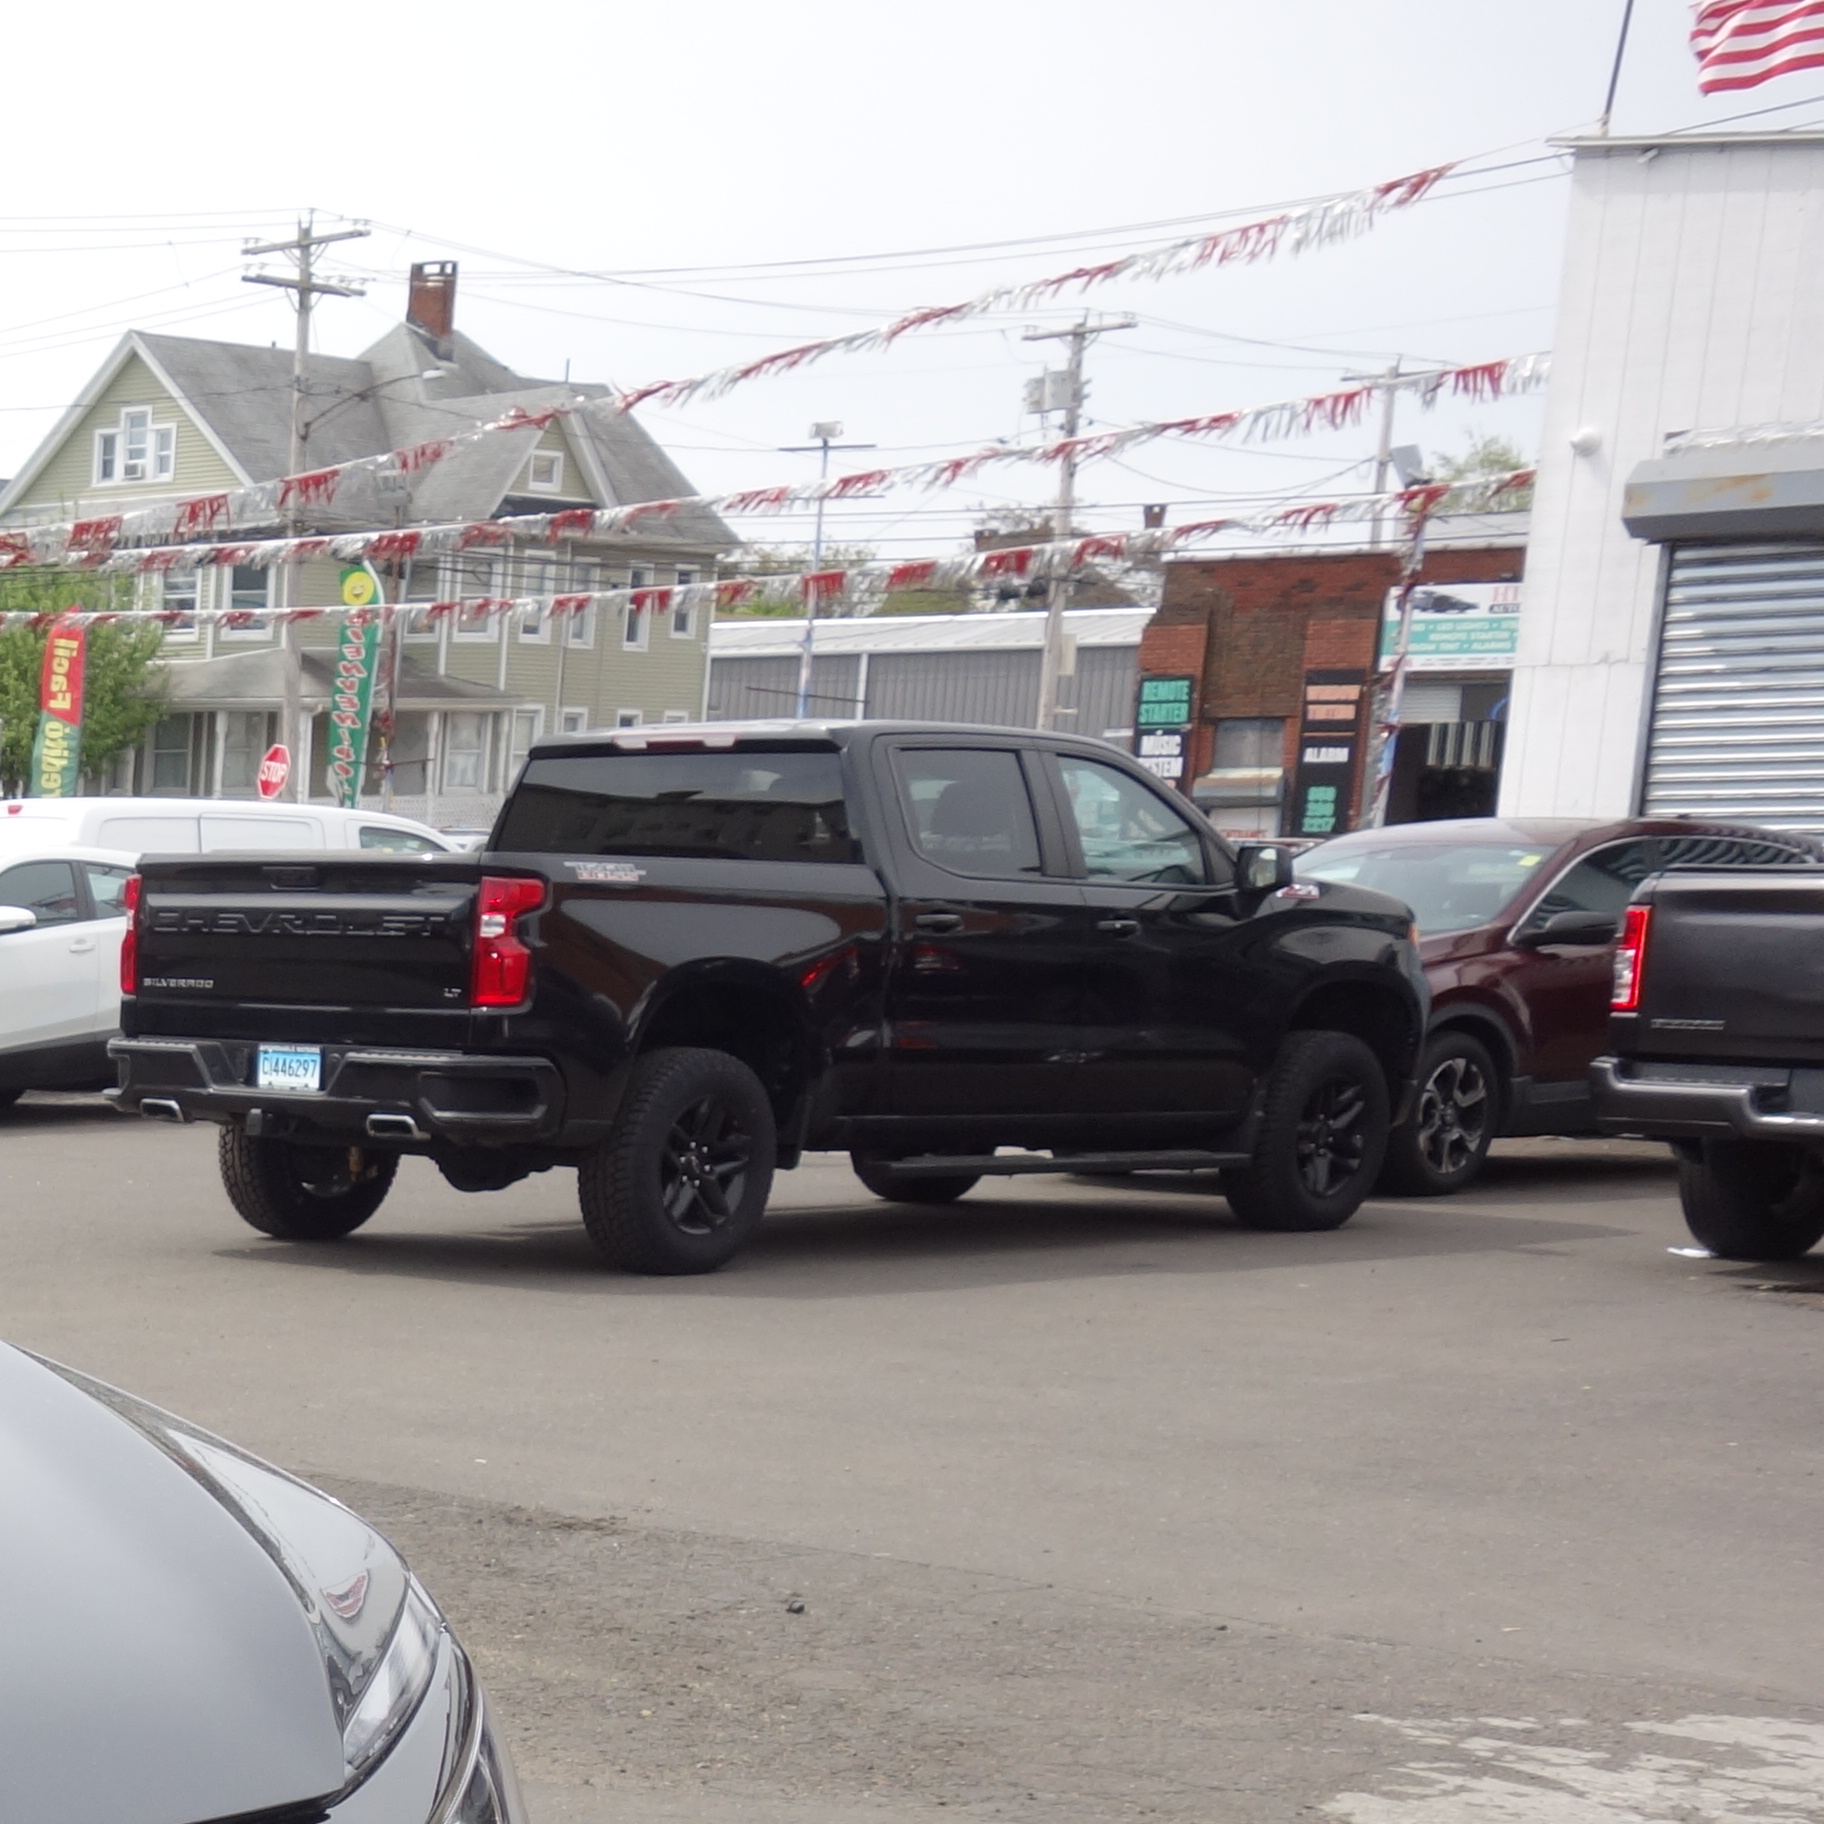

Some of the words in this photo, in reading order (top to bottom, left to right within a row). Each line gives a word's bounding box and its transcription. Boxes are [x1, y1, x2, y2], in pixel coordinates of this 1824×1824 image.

[1142, 681, 1190, 701] REMOTE
[1138, 703, 1189, 723] STARTER
[1140, 735, 1182, 756] MUSIC
[1304, 747, 1350, 763] ALARM
[260, 760, 288, 783] STOP
[153, 911, 446, 937] CHEVROLET
[143, 977, 214, 989] SILVERADO
